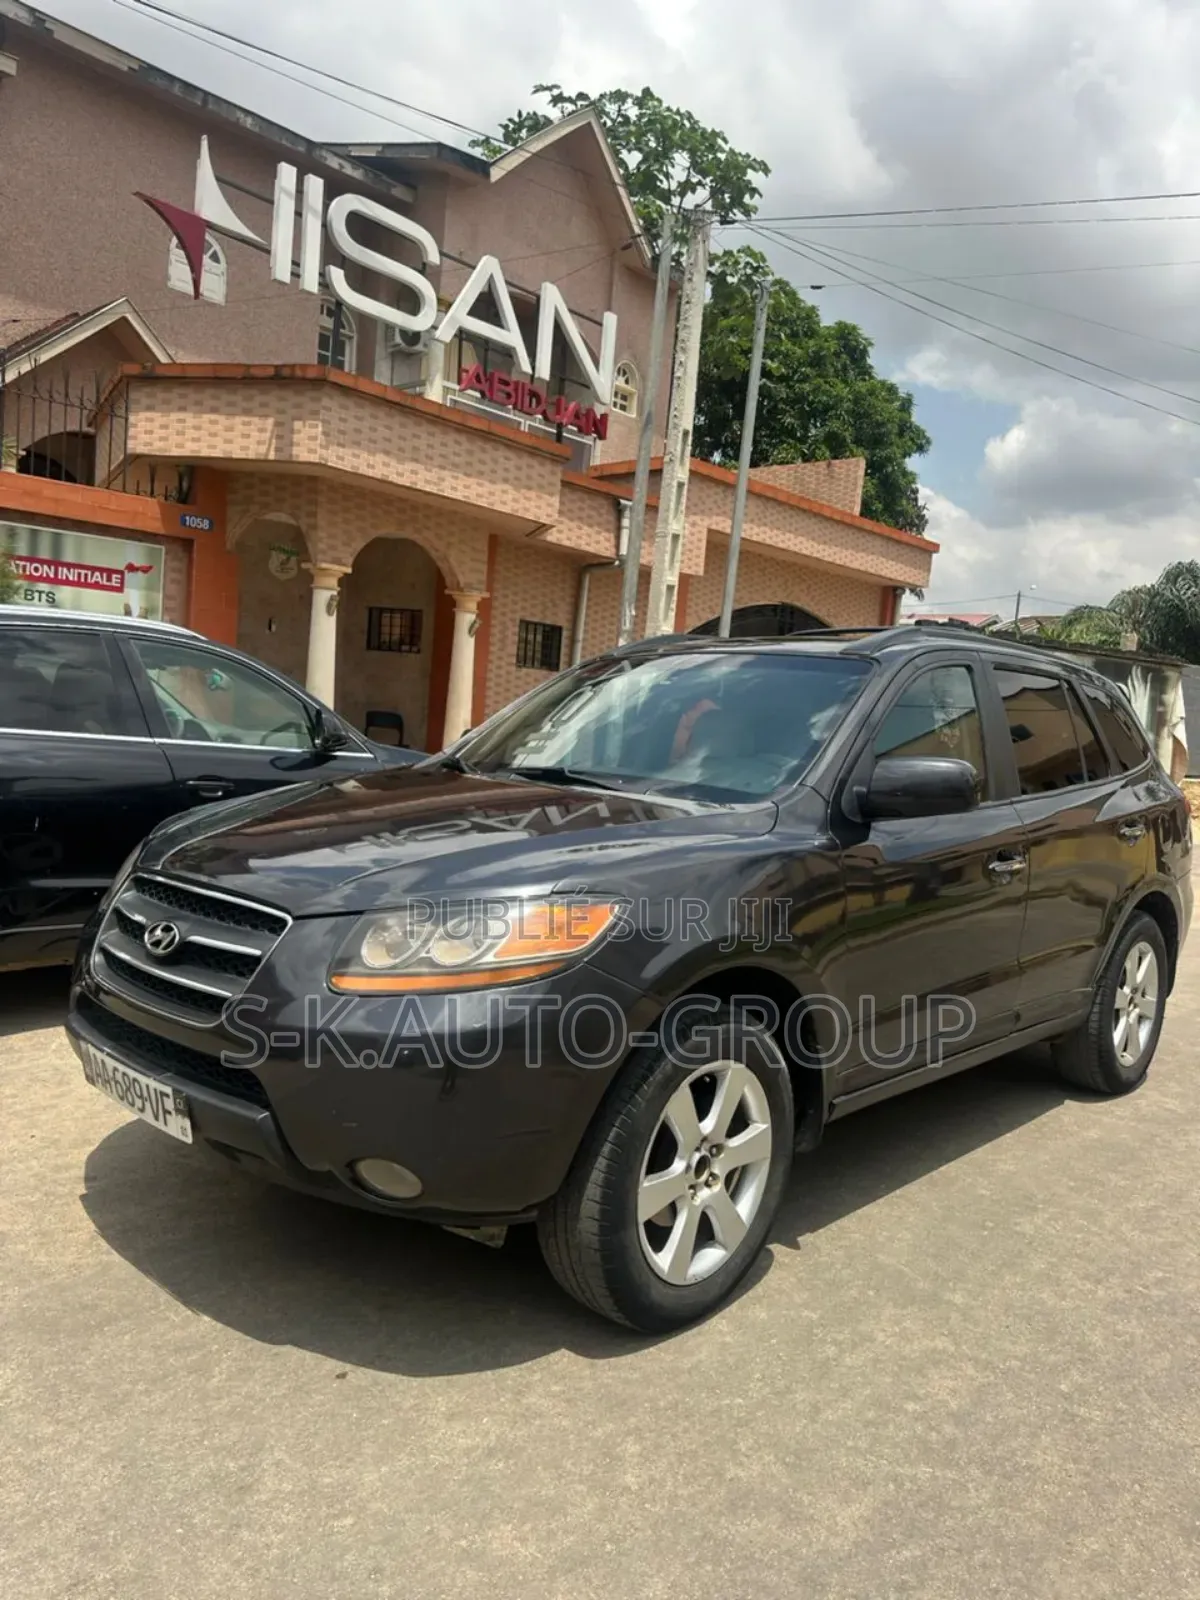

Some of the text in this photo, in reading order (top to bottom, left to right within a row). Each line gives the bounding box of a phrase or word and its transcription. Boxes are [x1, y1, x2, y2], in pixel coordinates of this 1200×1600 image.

[459, 363, 609, 441] ABIDJAN
[184, 515, 210, 530] 1058
[58, 566, 121, 587] INITIALE
[24, 588, 56, 605] BTS
